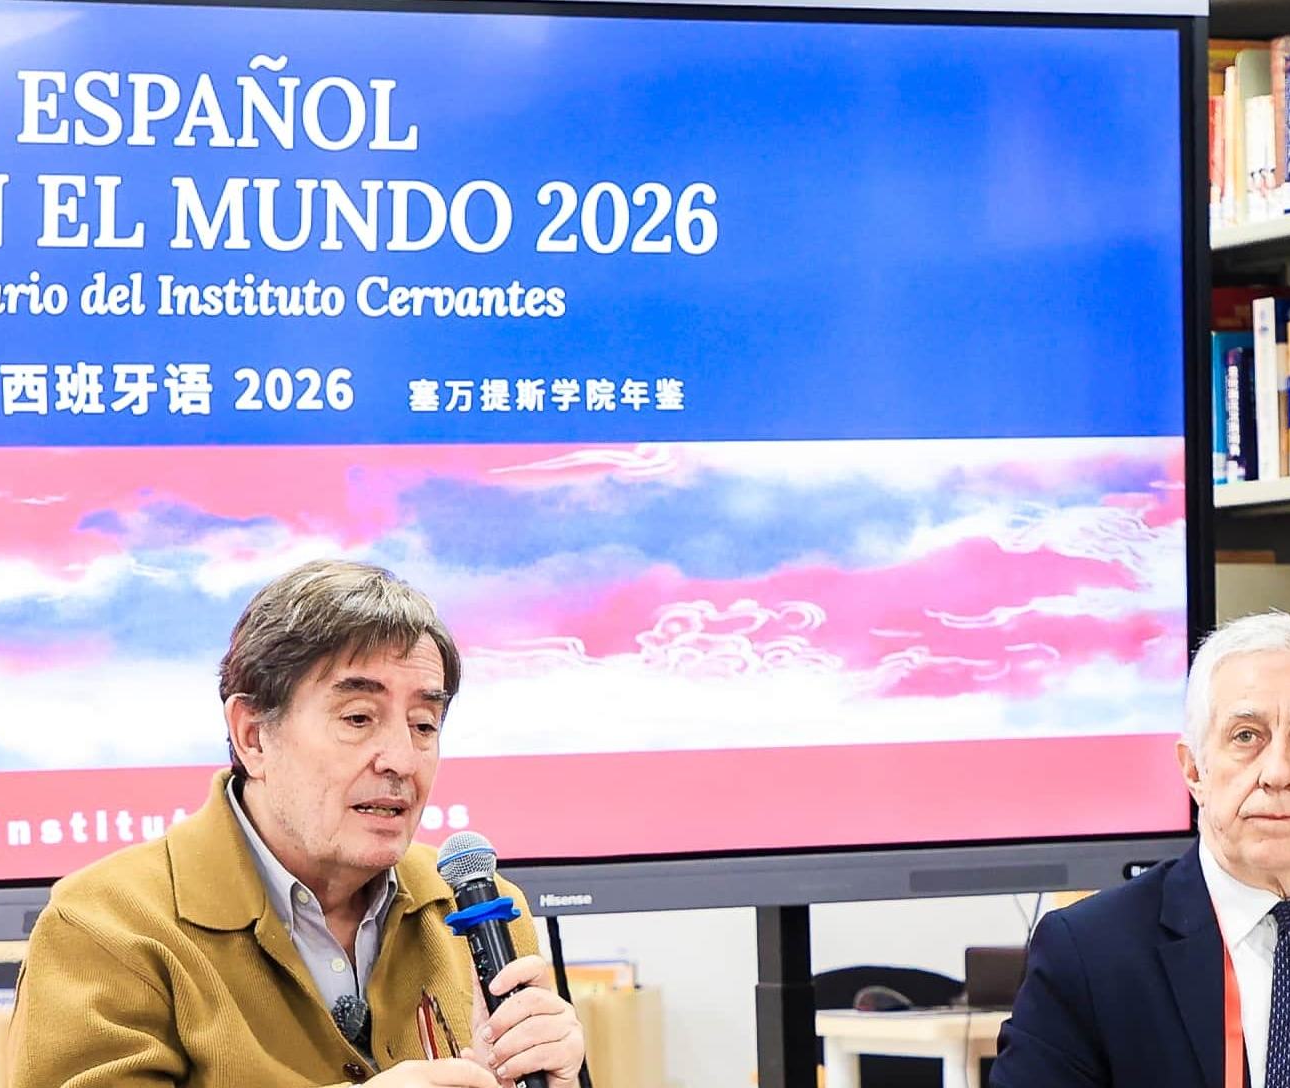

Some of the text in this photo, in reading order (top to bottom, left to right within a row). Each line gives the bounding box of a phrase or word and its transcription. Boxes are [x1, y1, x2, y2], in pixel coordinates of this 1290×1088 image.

[16, 54, 418, 151] ESPAÑOL
[37, 174, 145, 250] EL
[170, 177, 513, 253] MUNDO
[535, 182, 719, 256] 2026
[80, 273, 146, 317] del
[157, 275, 345, 317] Instituto
[356, 277, 566, 318] Cervantes
[234, 367, 354, 412] 2026
[409, 378, 686, 413] 塞万提斯学院年鉴
[540, 894, 592, 907] Hisense
